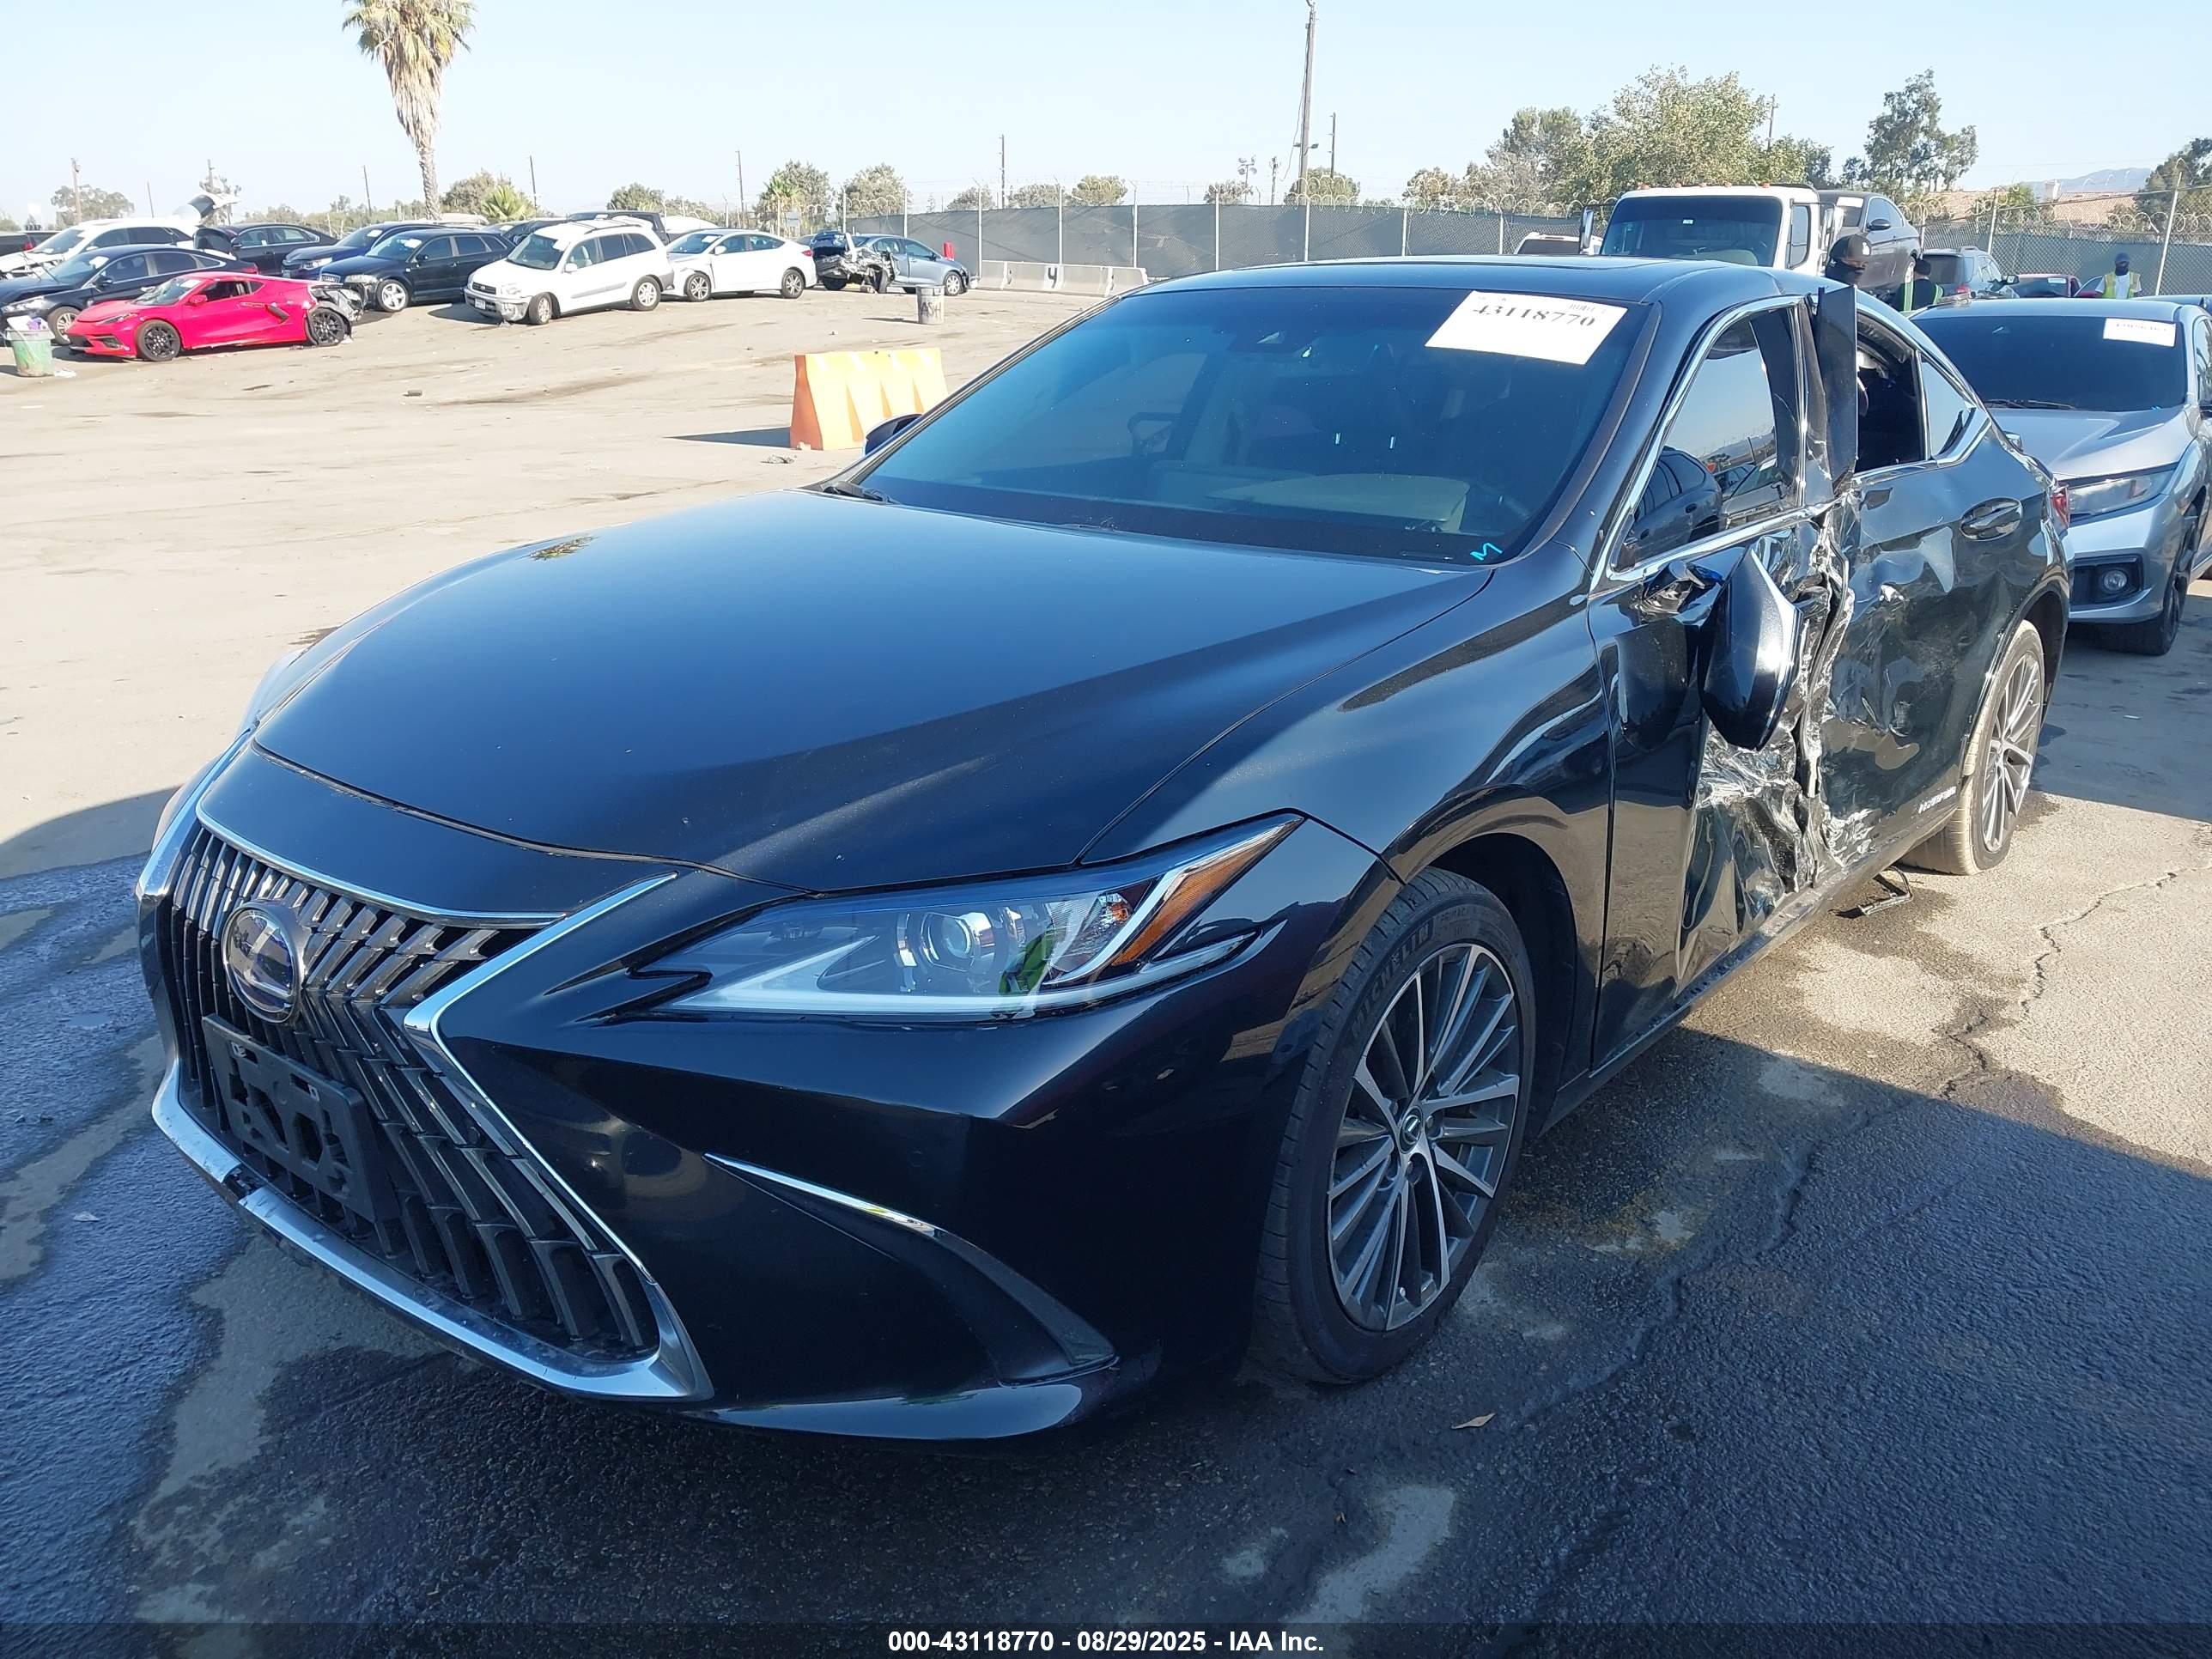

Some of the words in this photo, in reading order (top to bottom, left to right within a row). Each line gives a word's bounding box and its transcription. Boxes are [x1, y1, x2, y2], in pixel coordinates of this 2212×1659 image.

[1048, 267, 1058, 289] 4
[1473, 304, 1596, 327] 43118770
[1352, 921, 1430, 1039] MICHELIN
